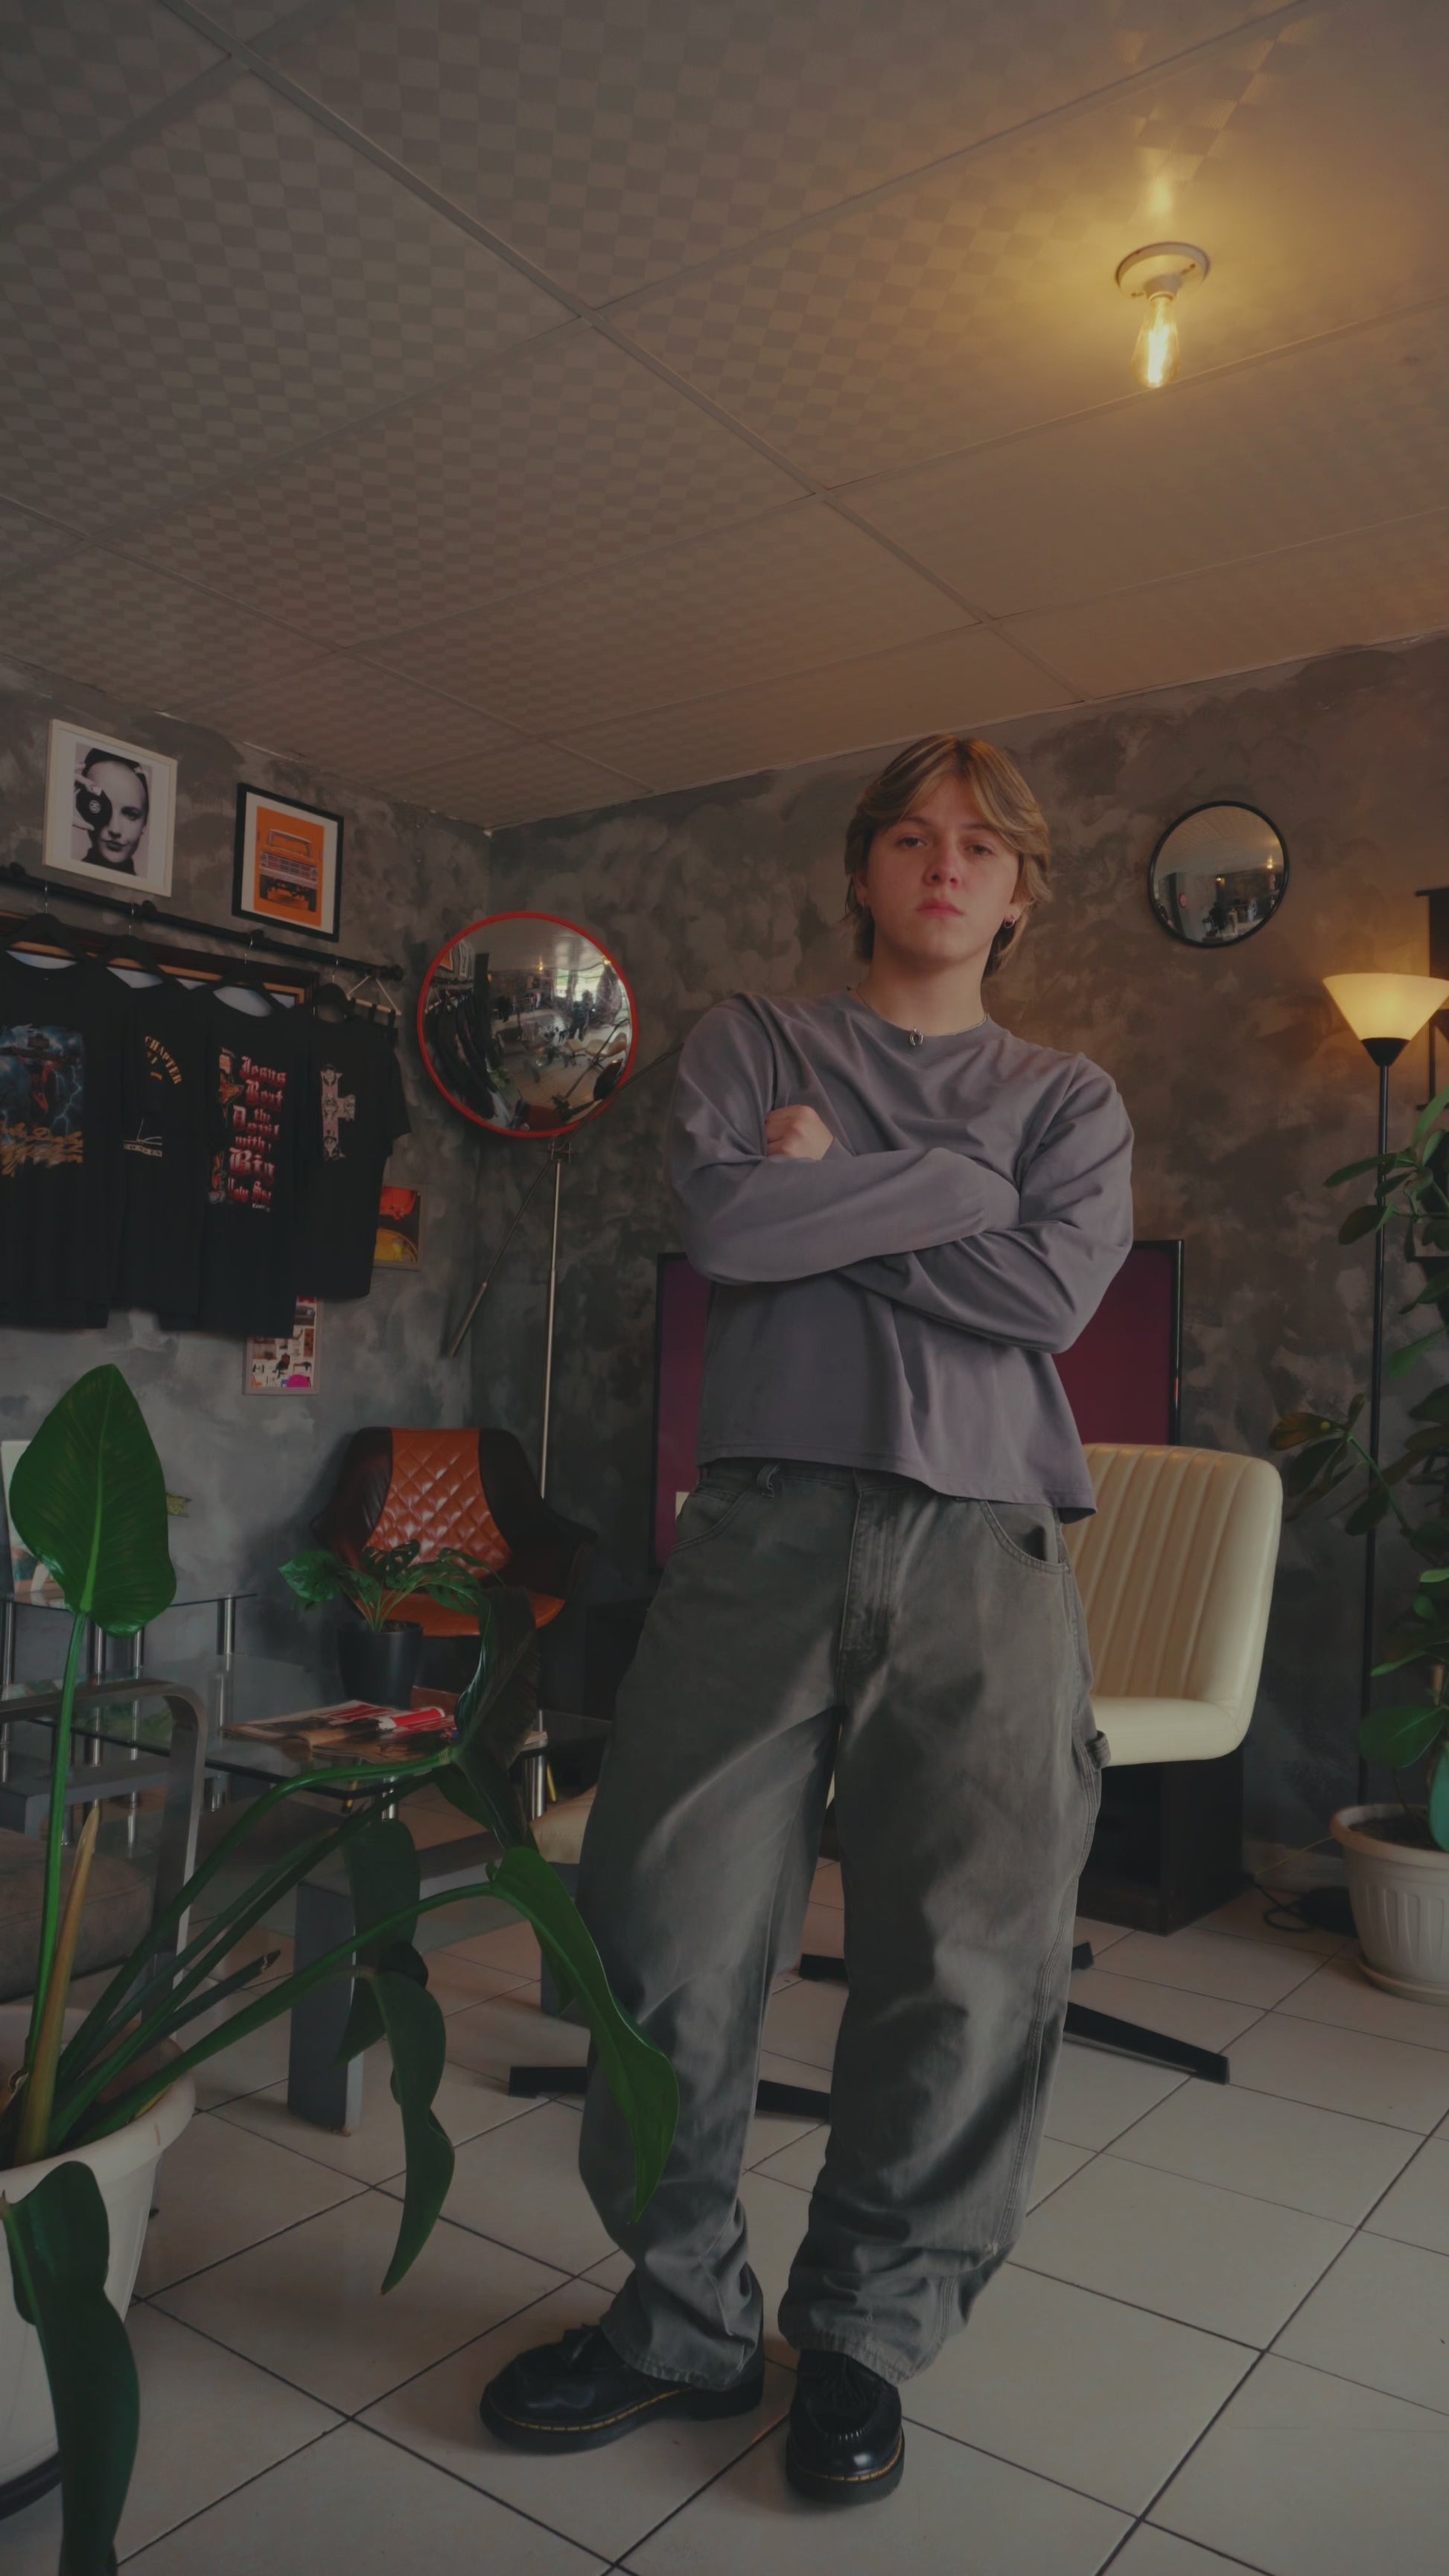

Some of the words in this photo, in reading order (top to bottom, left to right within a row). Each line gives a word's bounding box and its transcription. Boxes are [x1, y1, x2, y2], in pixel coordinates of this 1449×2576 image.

[144, 1036, 182, 1085] CHAPTER
[240, 1055, 287, 1088] Jesus
[232, 1104, 281, 1141] Devil
[228, 1147, 276, 1187] Big
